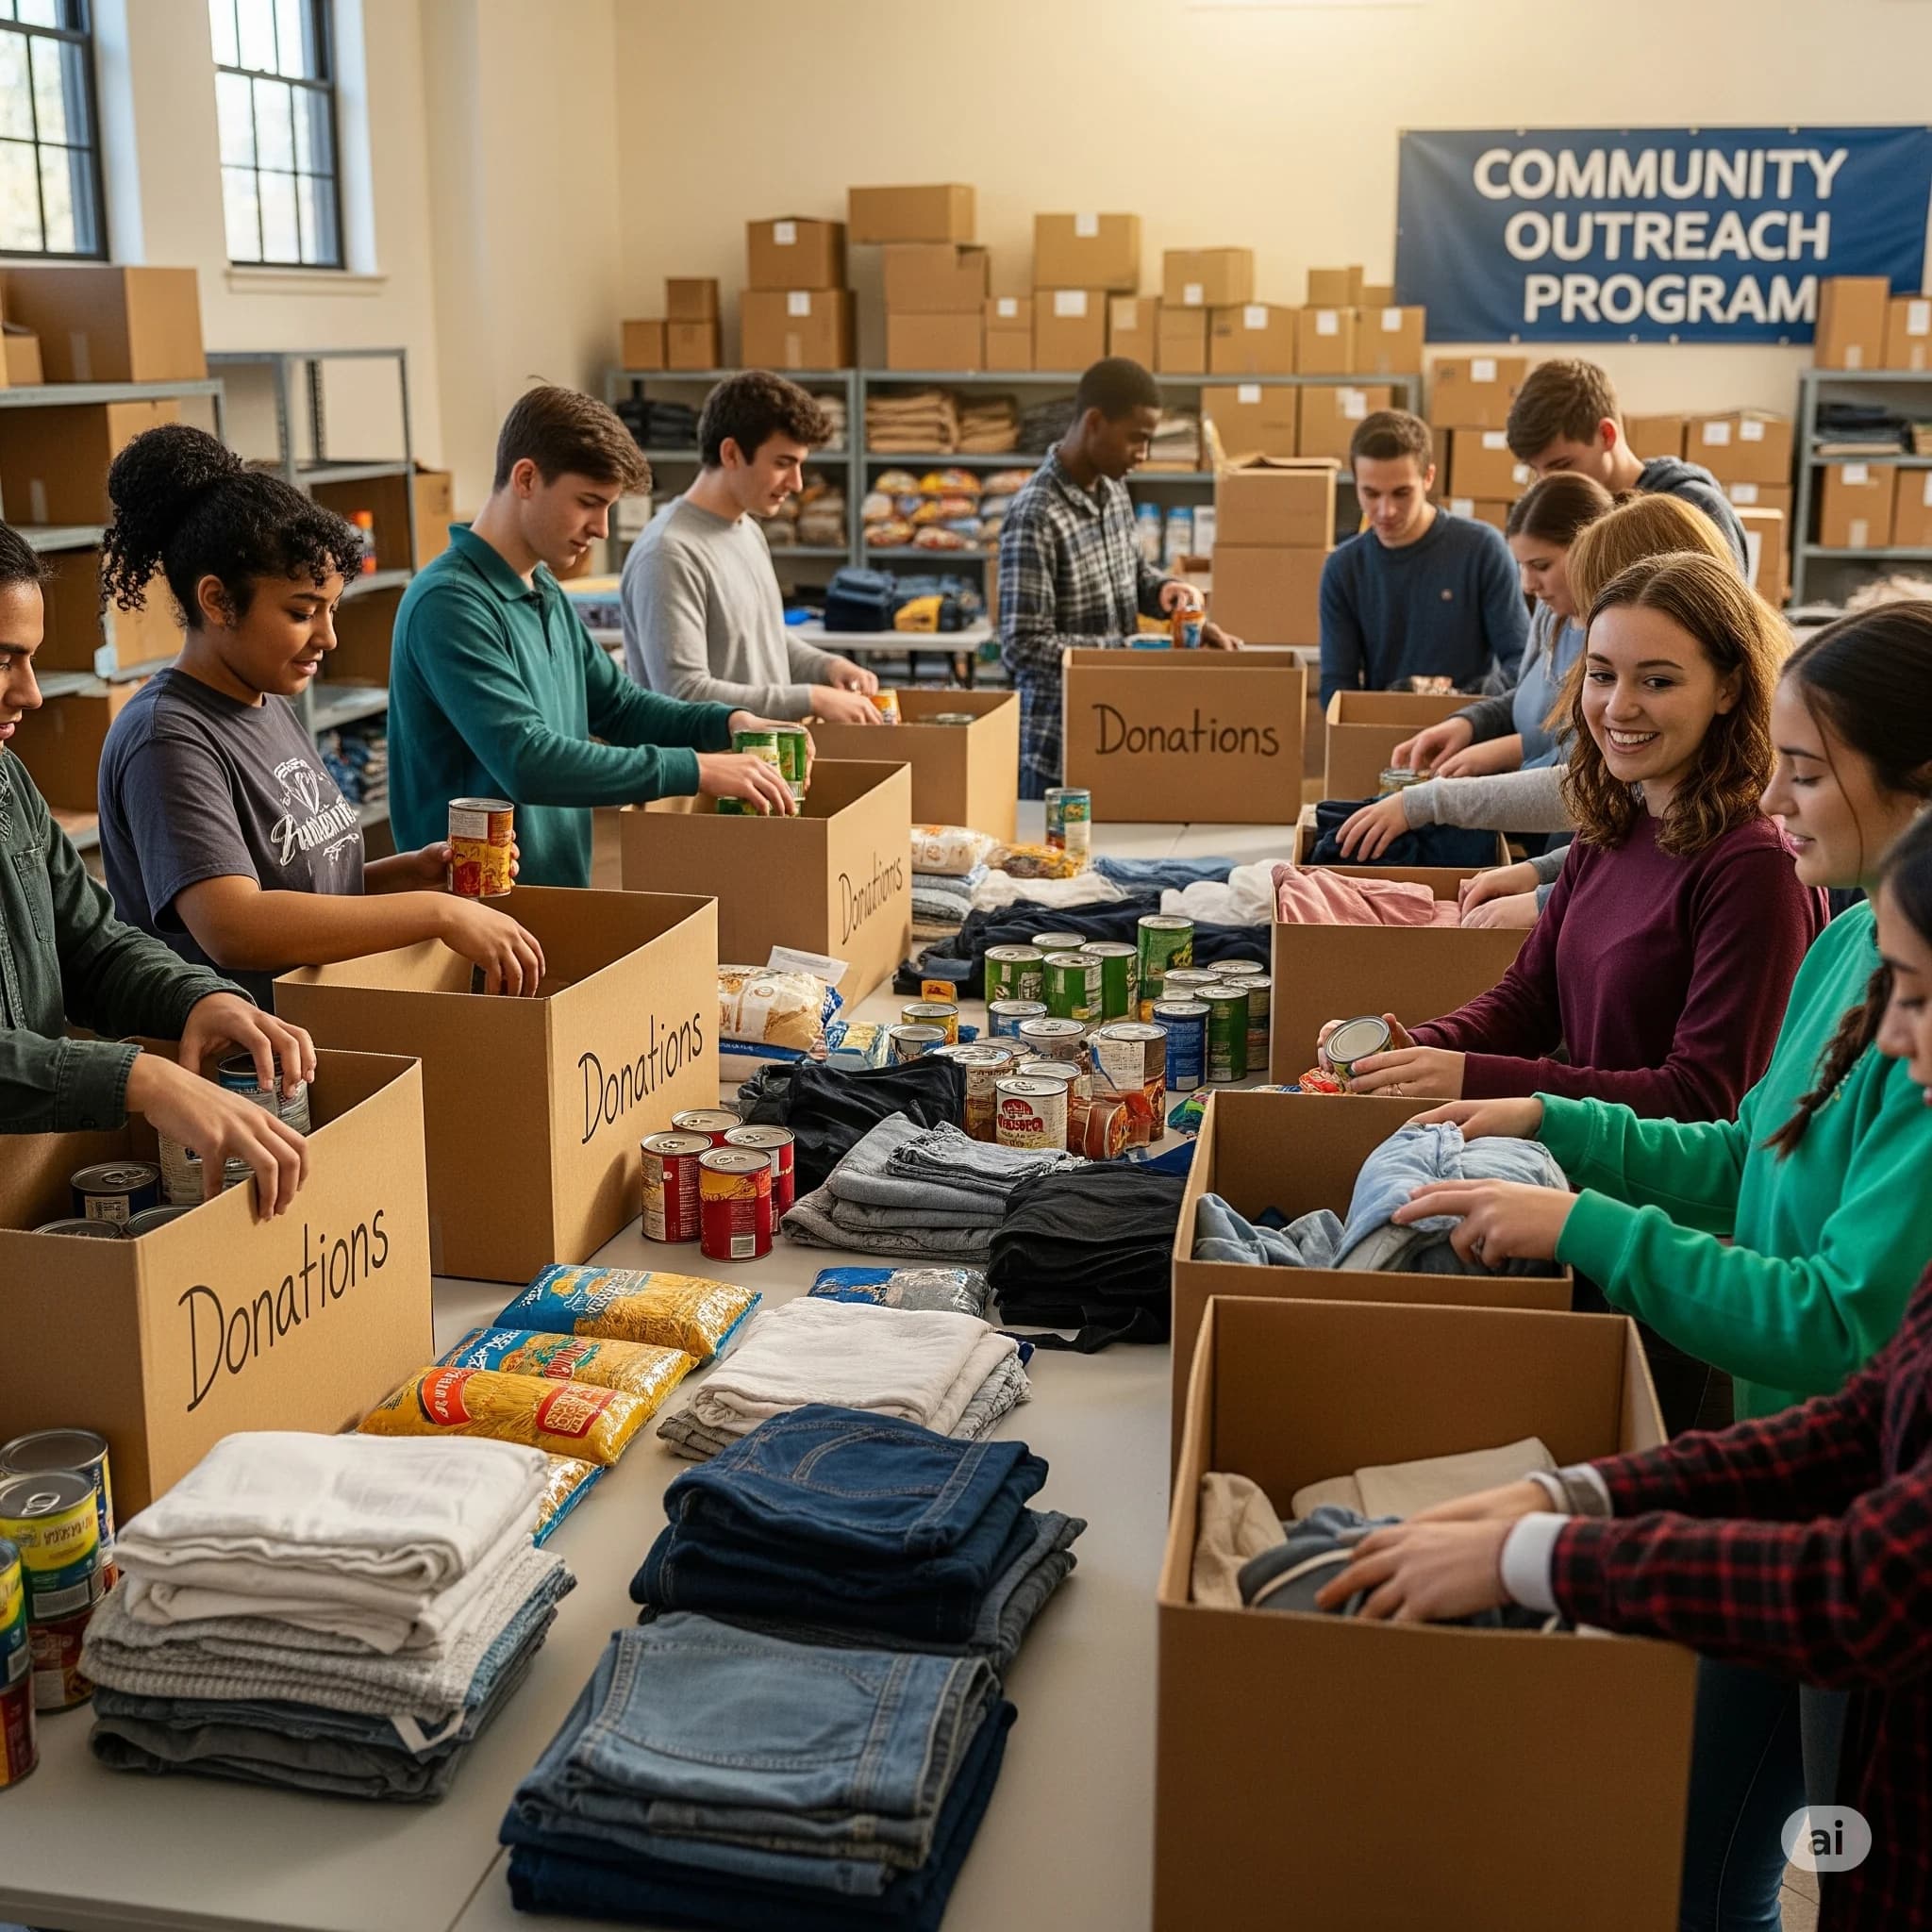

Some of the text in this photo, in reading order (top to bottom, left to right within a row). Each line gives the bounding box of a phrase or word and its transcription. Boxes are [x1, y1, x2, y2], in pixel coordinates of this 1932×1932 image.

[1474, 148, 1848, 200] COMMUNITY
[1505, 210, 1830, 261] OUTREACH
[1524, 275, 1818, 325] PROGRAM
[1091, 703, 1280, 757] Donations
[838, 851, 903, 945] Donations
[577, 1012, 703, 1144] Donations
[177, 1208, 389, 1412] Donations
